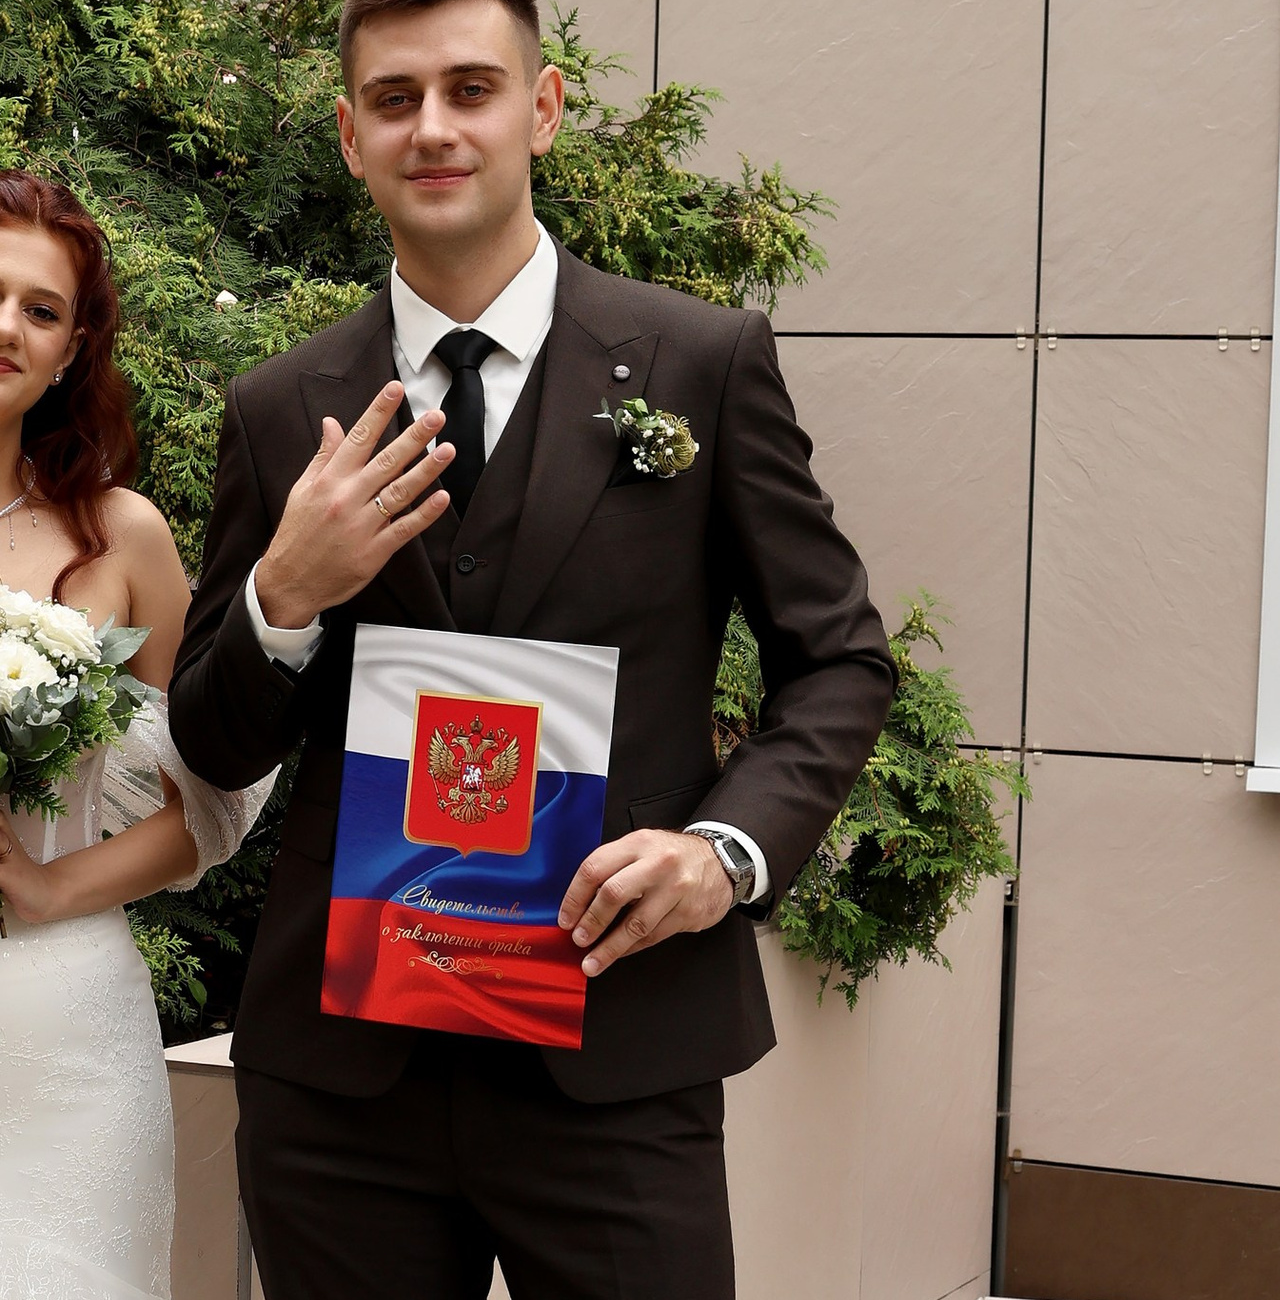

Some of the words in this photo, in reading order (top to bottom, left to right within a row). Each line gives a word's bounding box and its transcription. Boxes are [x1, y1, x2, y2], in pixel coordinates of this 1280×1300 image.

[396, 884, 526, 920] Свидетельство
[381, 925, 391, 936] о
[390, 923, 484, 950] заключении
[487, 933, 533, 957] брака
